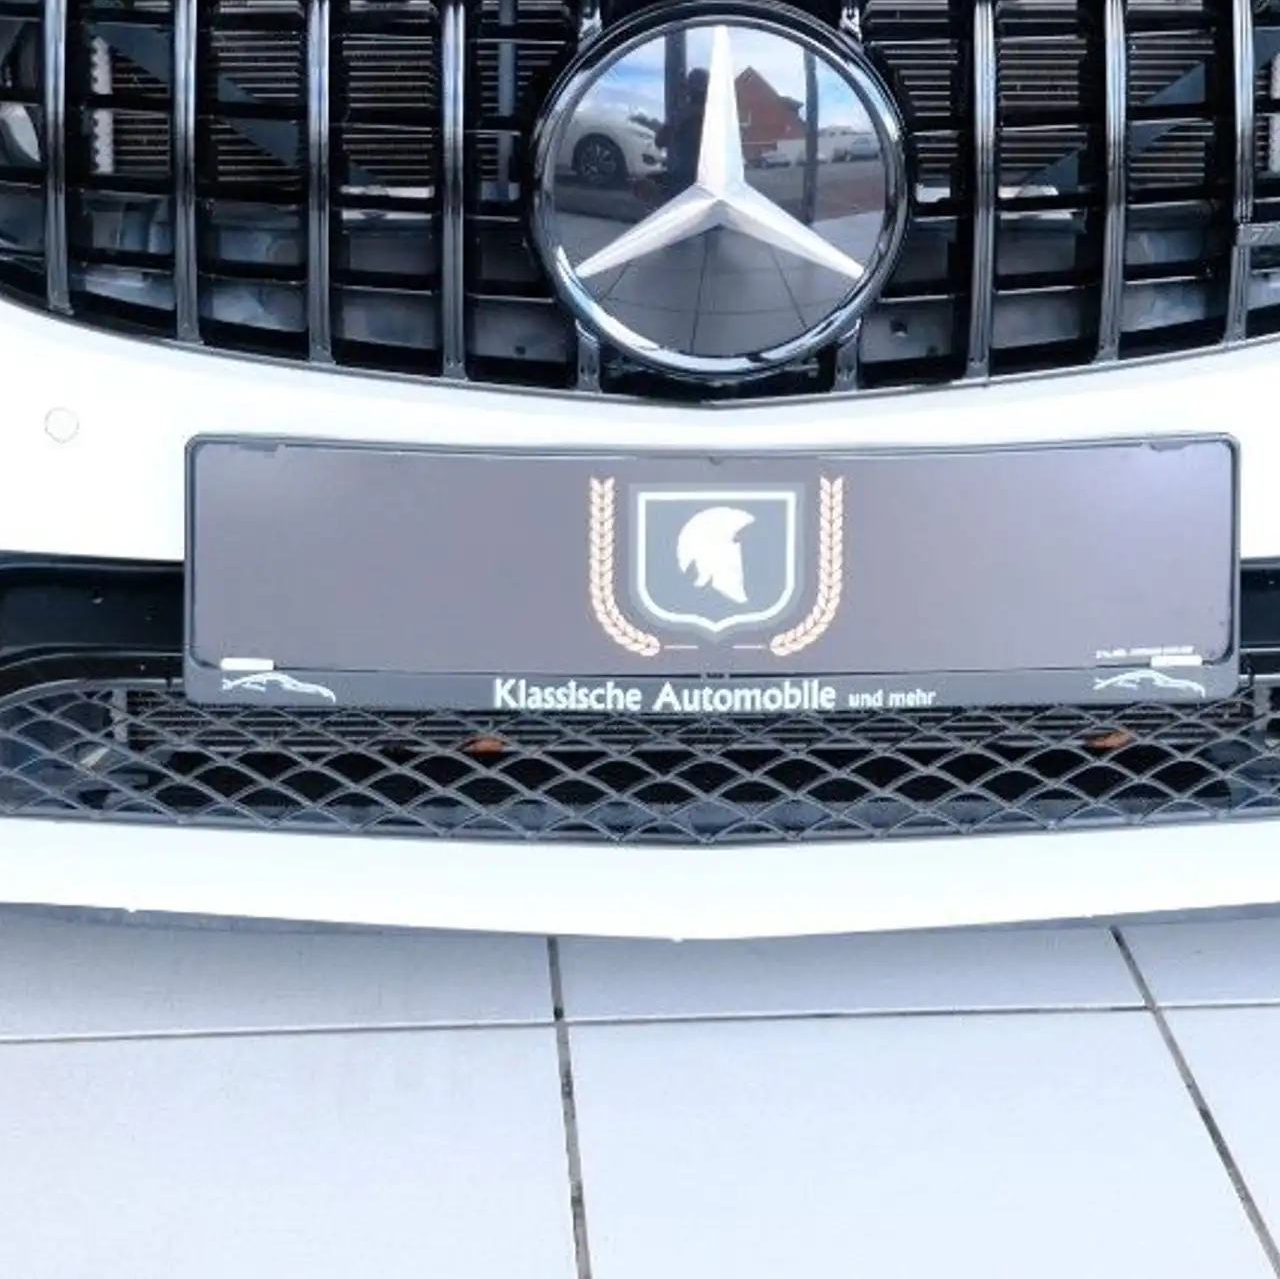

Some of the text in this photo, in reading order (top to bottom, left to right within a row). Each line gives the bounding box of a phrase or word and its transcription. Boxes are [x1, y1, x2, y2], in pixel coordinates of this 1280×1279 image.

[494, 677, 937, 711] Klassische Automobile und mehr
